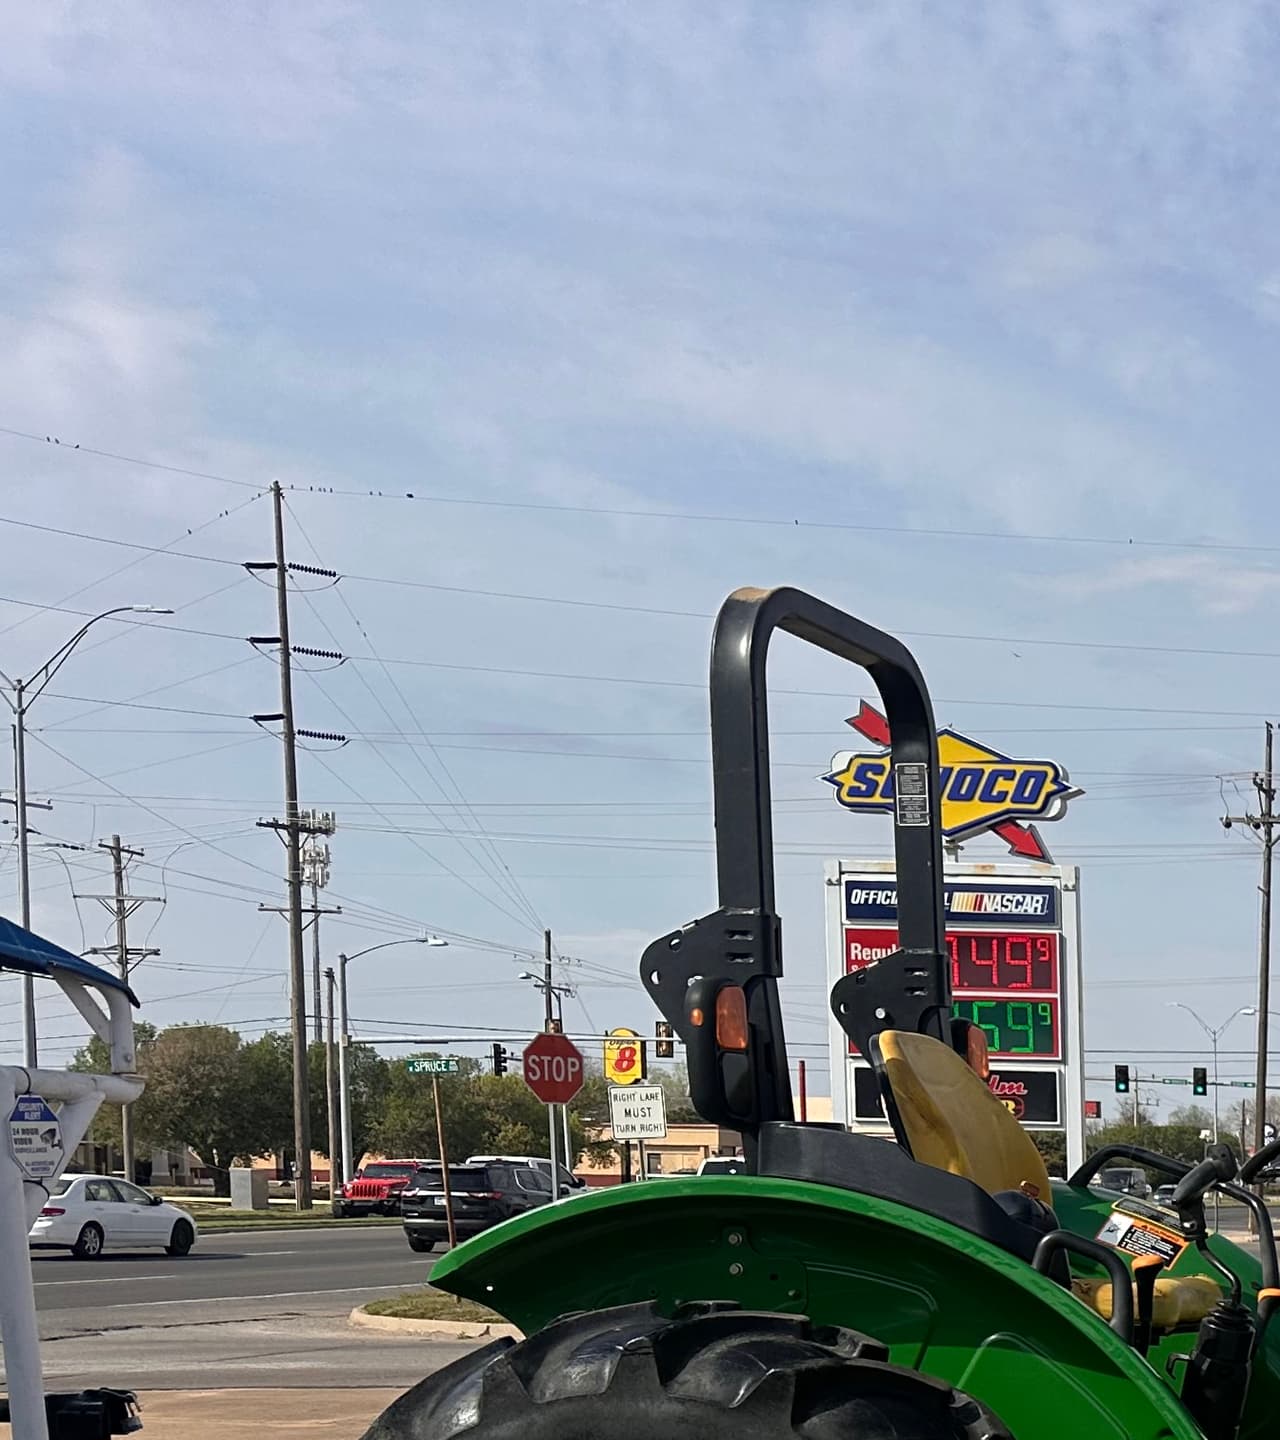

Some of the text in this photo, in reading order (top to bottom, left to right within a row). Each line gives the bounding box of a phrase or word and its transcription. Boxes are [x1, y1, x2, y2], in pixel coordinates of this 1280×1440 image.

[847, 763, 1048, 804] SOCO
[982, 894, 1043, 914] NASCAR
[414, 1060, 448, 1072] SPRUCE
[528, 1055, 580, 1082] STOP
[613, 1092, 660, 1101] RIGHT LANE
[624, 1107, 652, 1118] MUST
[615, 1124, 662, 1134] TURN RIGHT
